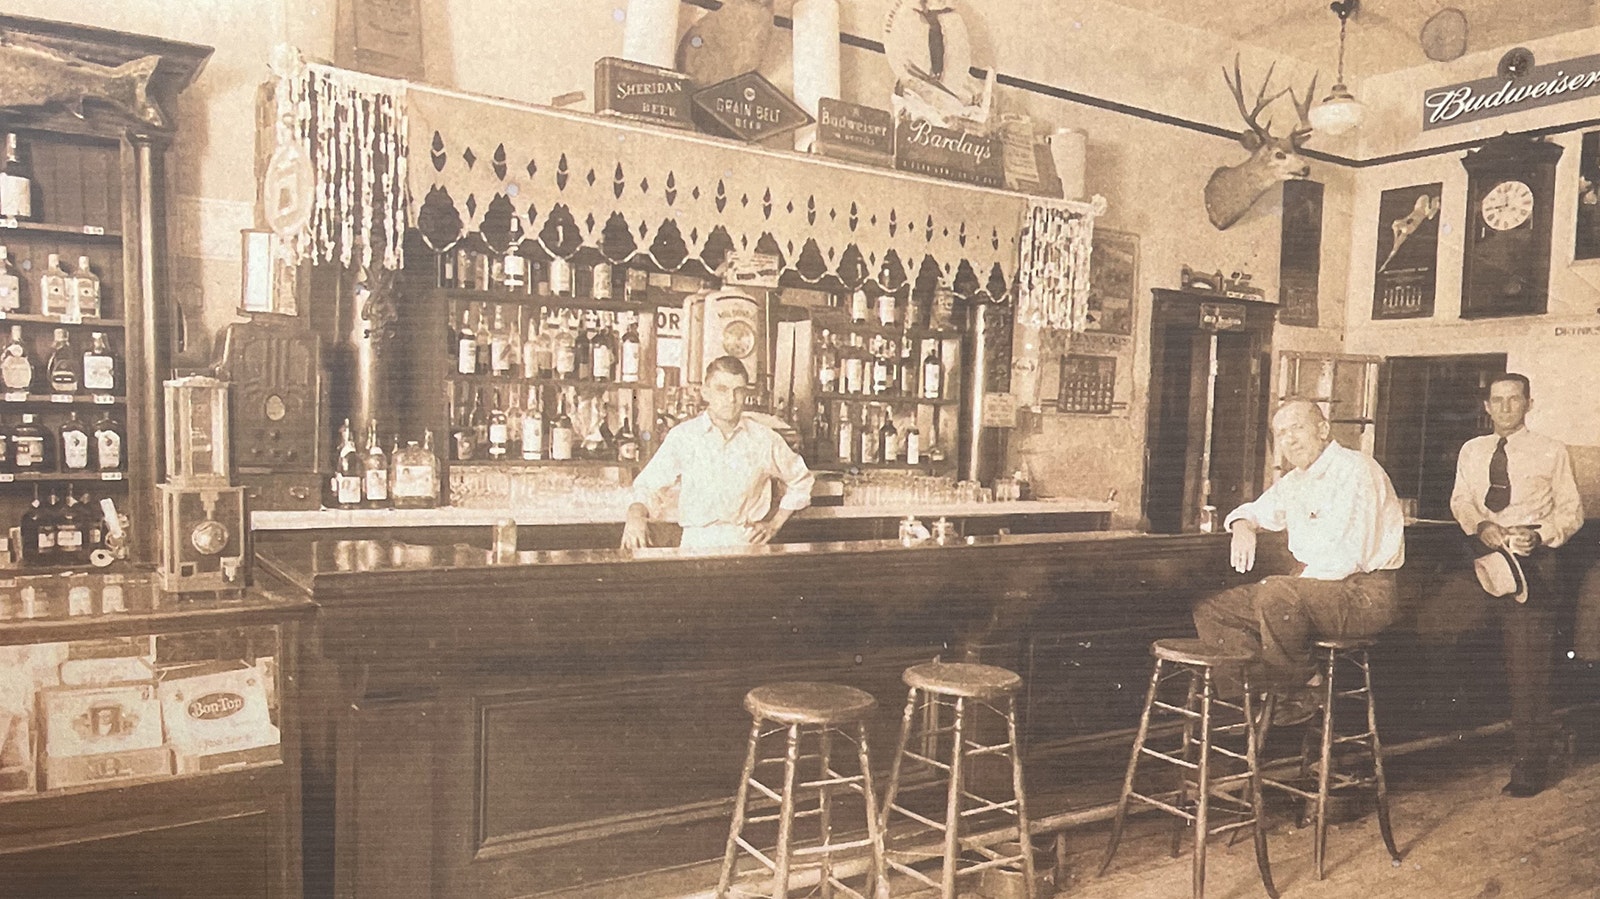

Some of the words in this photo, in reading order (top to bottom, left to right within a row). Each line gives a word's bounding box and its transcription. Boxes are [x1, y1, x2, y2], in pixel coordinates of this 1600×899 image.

[616, 81, 682, 100] SHERIDAN
[1425, 69, 1600, 123] Budweiser
[642, 102, 677, 117] BEER
[716, 97, 751, 117] GRAIN
[756, 105, 780, 123] BELT
[821, 110, 887, 137] Budweiser
[907, 118, 991, 165] Barclay's
